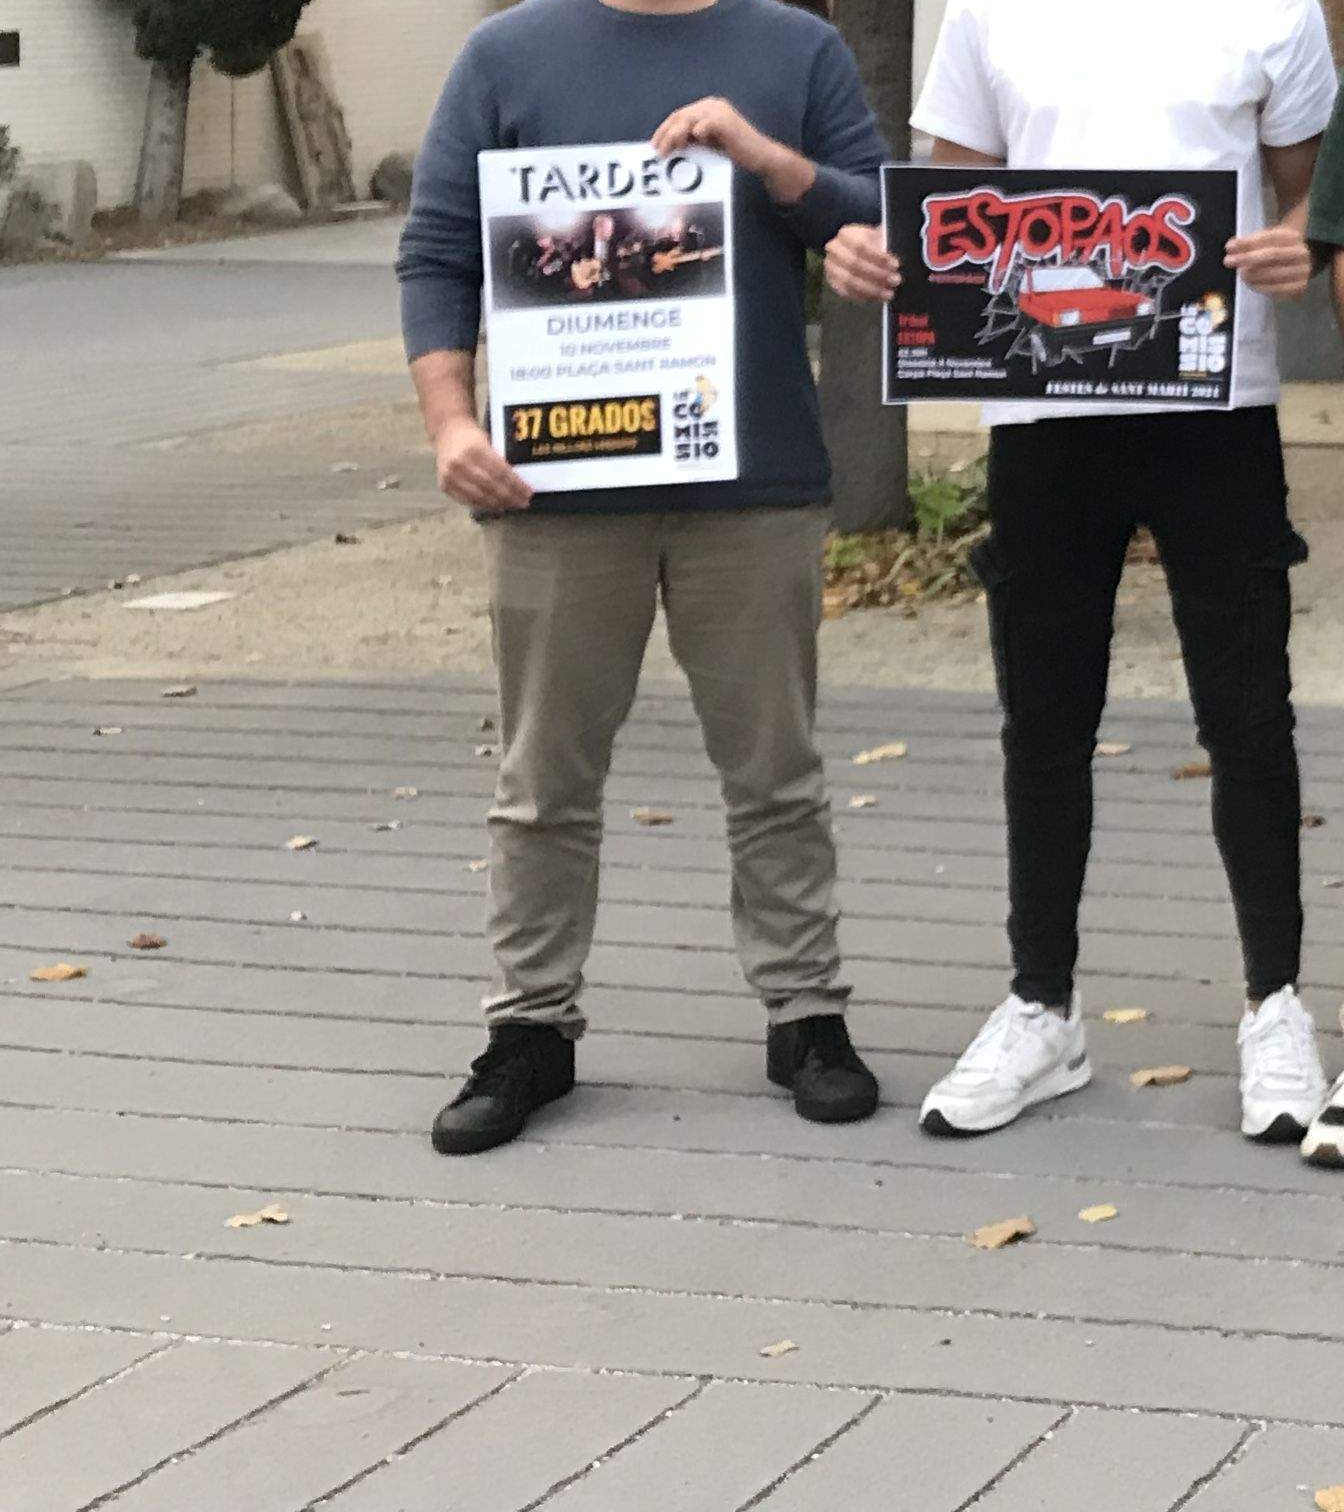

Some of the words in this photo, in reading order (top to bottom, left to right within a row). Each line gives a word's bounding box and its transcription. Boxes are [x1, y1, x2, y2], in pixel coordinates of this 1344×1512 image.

[510, 156, 703, 204] TARDEO
[547, 309, 681, 336] DIUMENGE
[513, 407, 543, 441] 37
[549, 399, 656, 438] GRADOS
